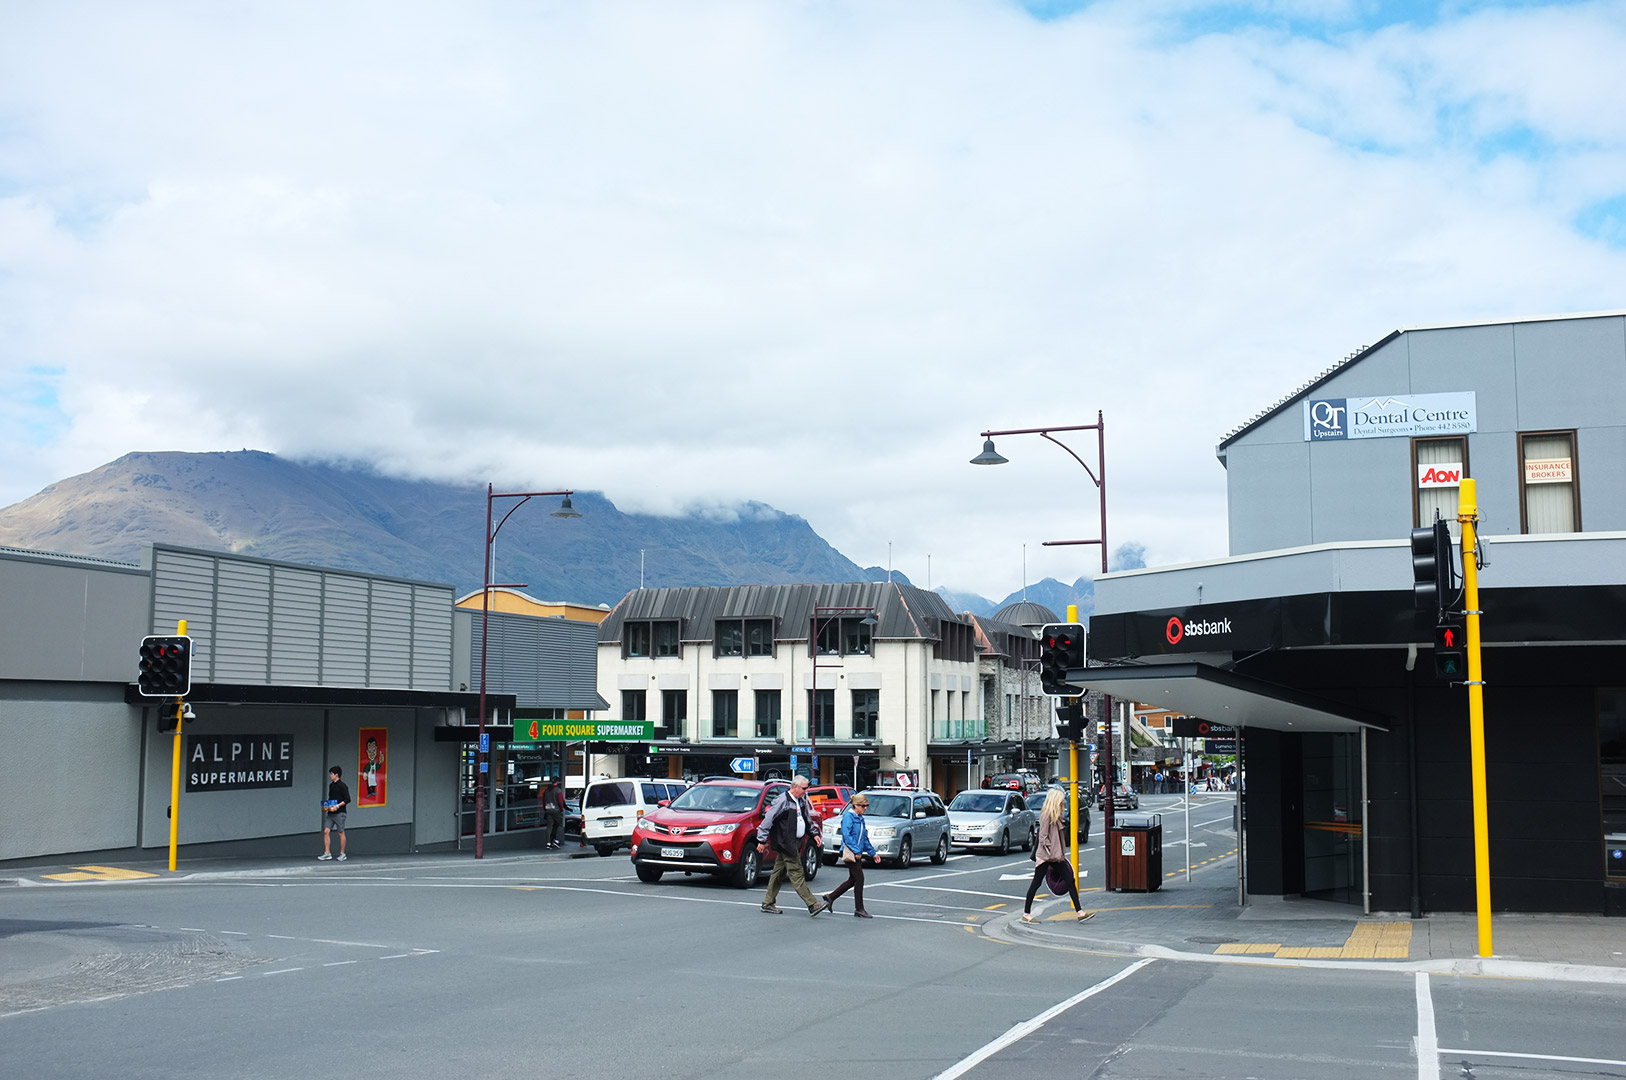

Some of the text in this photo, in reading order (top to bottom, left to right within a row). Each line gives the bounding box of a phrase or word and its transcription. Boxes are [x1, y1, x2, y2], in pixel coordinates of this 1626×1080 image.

[1311, 401, 1346, 430] QT
[1354, 408, 1469, 426] Dental Centre
[1314, 429, 1344, 439] Upstairs
[1354, 422, 1471, 435] Dental Surgeons Phone 442 8580
[1525, 463, 1571, 471] INSURANCE
[1184, 617, 1232, 637] sbsbank
[529, 720, 645, 740] 4 FOUR SQUARE SUPERMARKET
[1210, 724, 1236, 732] sbsban
[192, 741, 290, 763] ALPINE
[190, 770, 290, 785] SUPERMARKET
